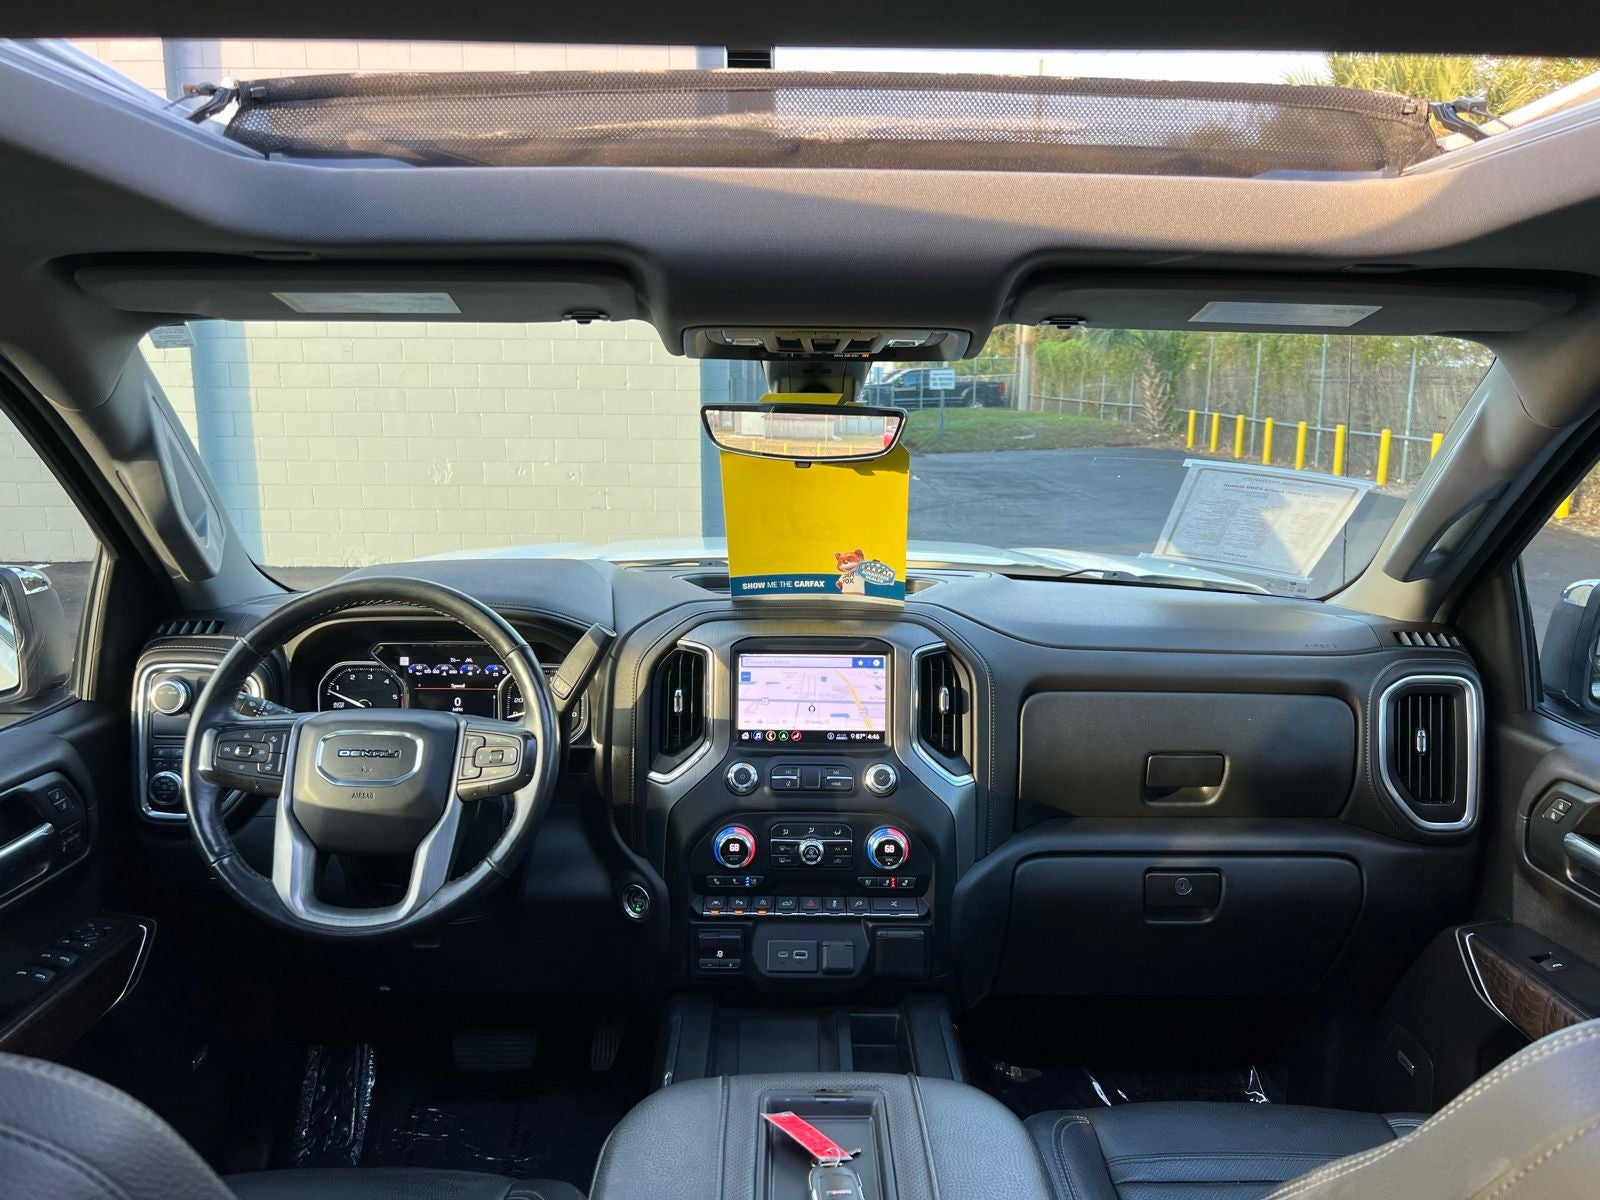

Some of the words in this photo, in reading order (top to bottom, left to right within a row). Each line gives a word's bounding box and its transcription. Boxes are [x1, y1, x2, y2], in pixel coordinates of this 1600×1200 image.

[742, 582, 765, 590] SHOW
[780, 580, 793, 588] THE
[794, 580, 825, 588] CARFAX
[454, 697, 462, 706] 0
[338, 749, 400, 758] DENALI
[352, 792, 375, 800] AIRBAG
[729, 843, 740, 852] 68
[884, 844, 895, 853] 68
